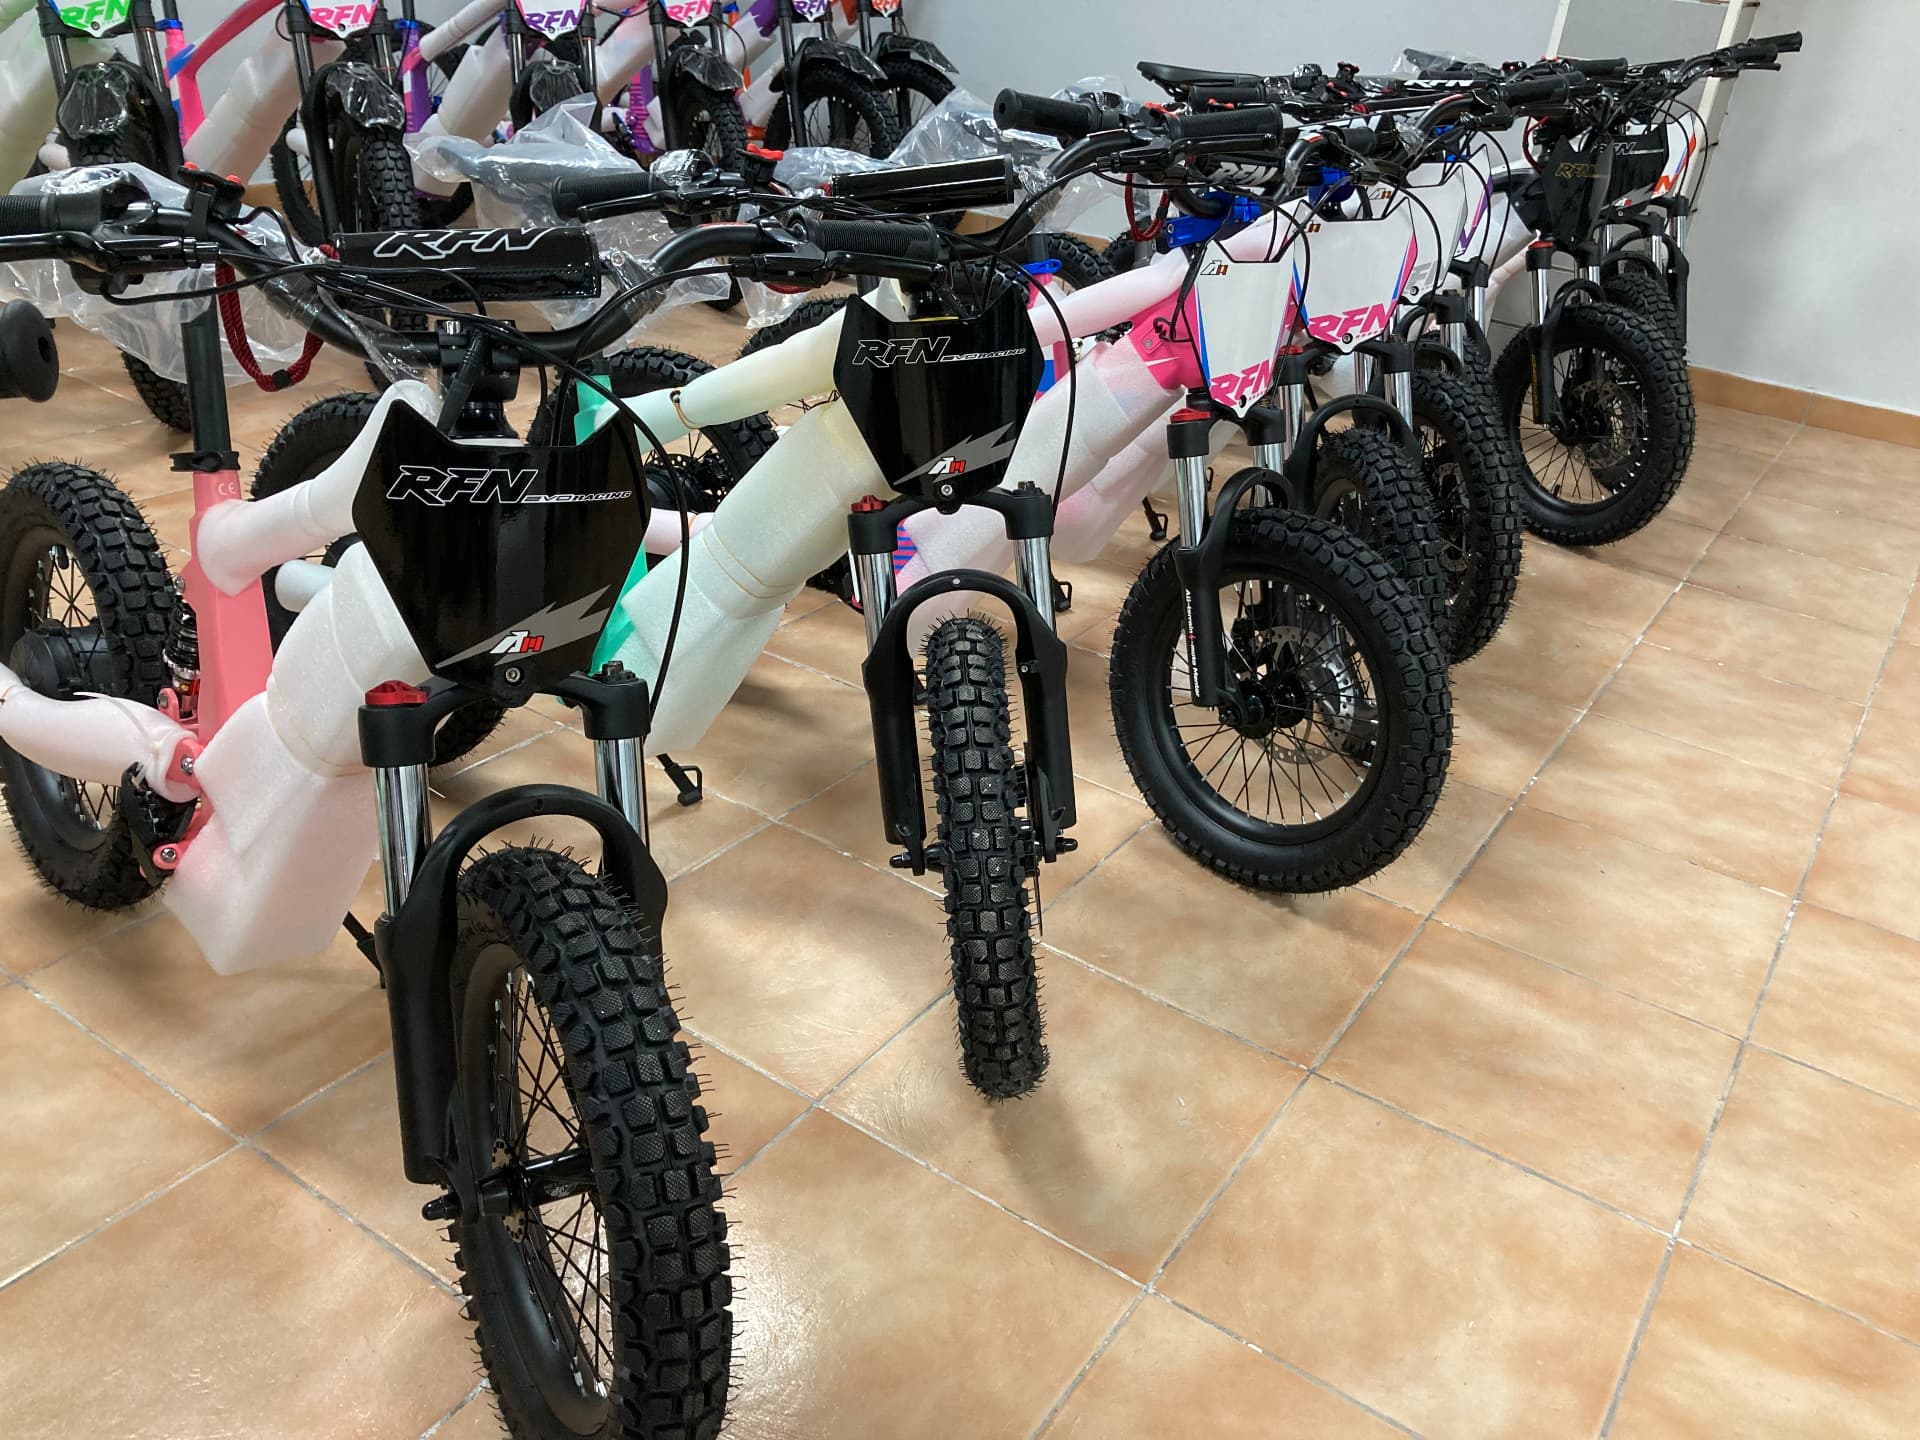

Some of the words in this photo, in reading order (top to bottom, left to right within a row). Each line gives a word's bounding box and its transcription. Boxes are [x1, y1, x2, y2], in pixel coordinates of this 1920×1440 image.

[60, 0, 129, 28] RFN
[308, 4, 376, 29] RFN
[525, 9, 583, 33] RFN
[667, 0, 711, 18] RFN
[373, 228, 561, 261] RFN
[1308, 303, 1394, 343] RFN
[852, 335, 951, 369] RFN
[1210, 359, 1271, 407] RFN
[385, 464, 539, 507] RFN
